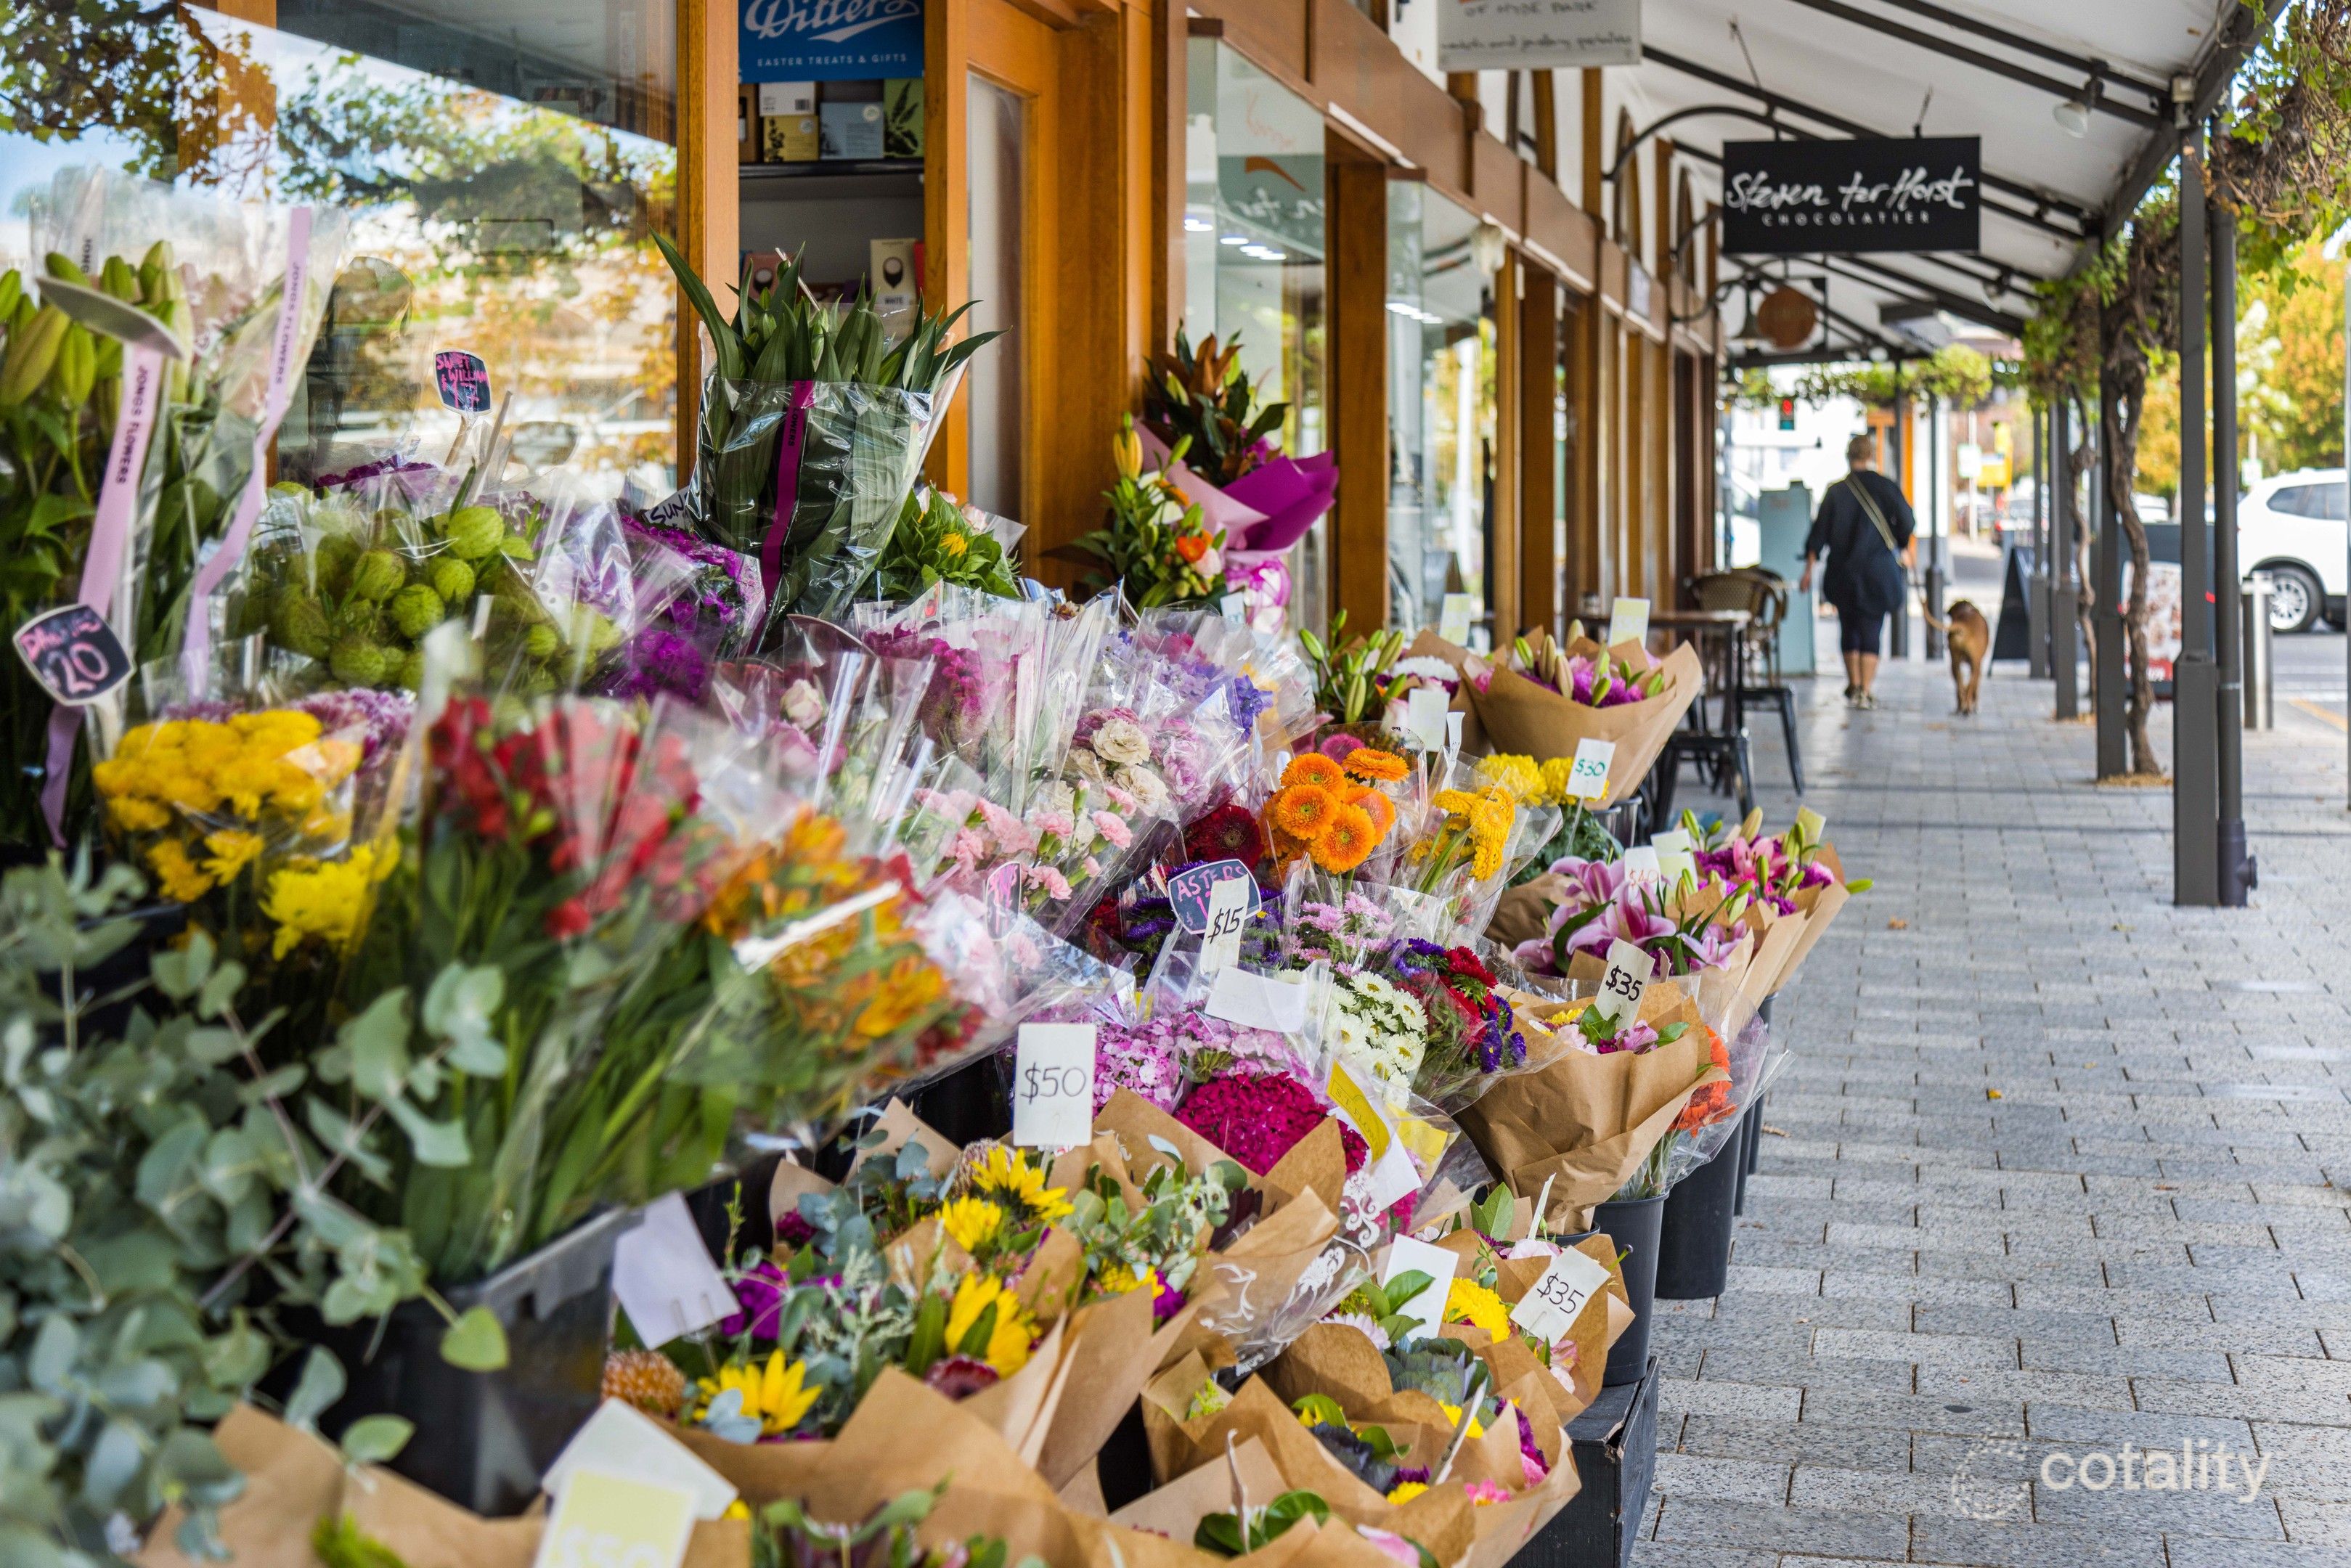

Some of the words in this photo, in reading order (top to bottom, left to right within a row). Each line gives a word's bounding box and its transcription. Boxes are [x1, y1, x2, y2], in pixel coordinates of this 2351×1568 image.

[757, 57, 802, 67] EASTER
[808, 54, 852, 65] TREATS
[858, 55, 866, 64] &
[872, 54, 907, 63] GIFTS
[1724, 170, 1830, 213] Steven
[1838, 171, 1891, 212] ter
[1886, 166, 1974, 211] Horst
[1761, 211, 1930, 226] CHOCOLATIER
[288, 261, 300, 311] JONES
[274, 316, 293, 385] FLOWERS
[788, 407, 799, 446] LOWERS
[115, 422, 139, 484] FLOWERS
[1576, 759, 1605, 776] $30
[1207, 907, 1244, 944] $15
[1605, 965, 1642, 1001] $35
[1021, 1062, 1086, 1105] $50
[1537, 1273, 1584, 1313] $35
